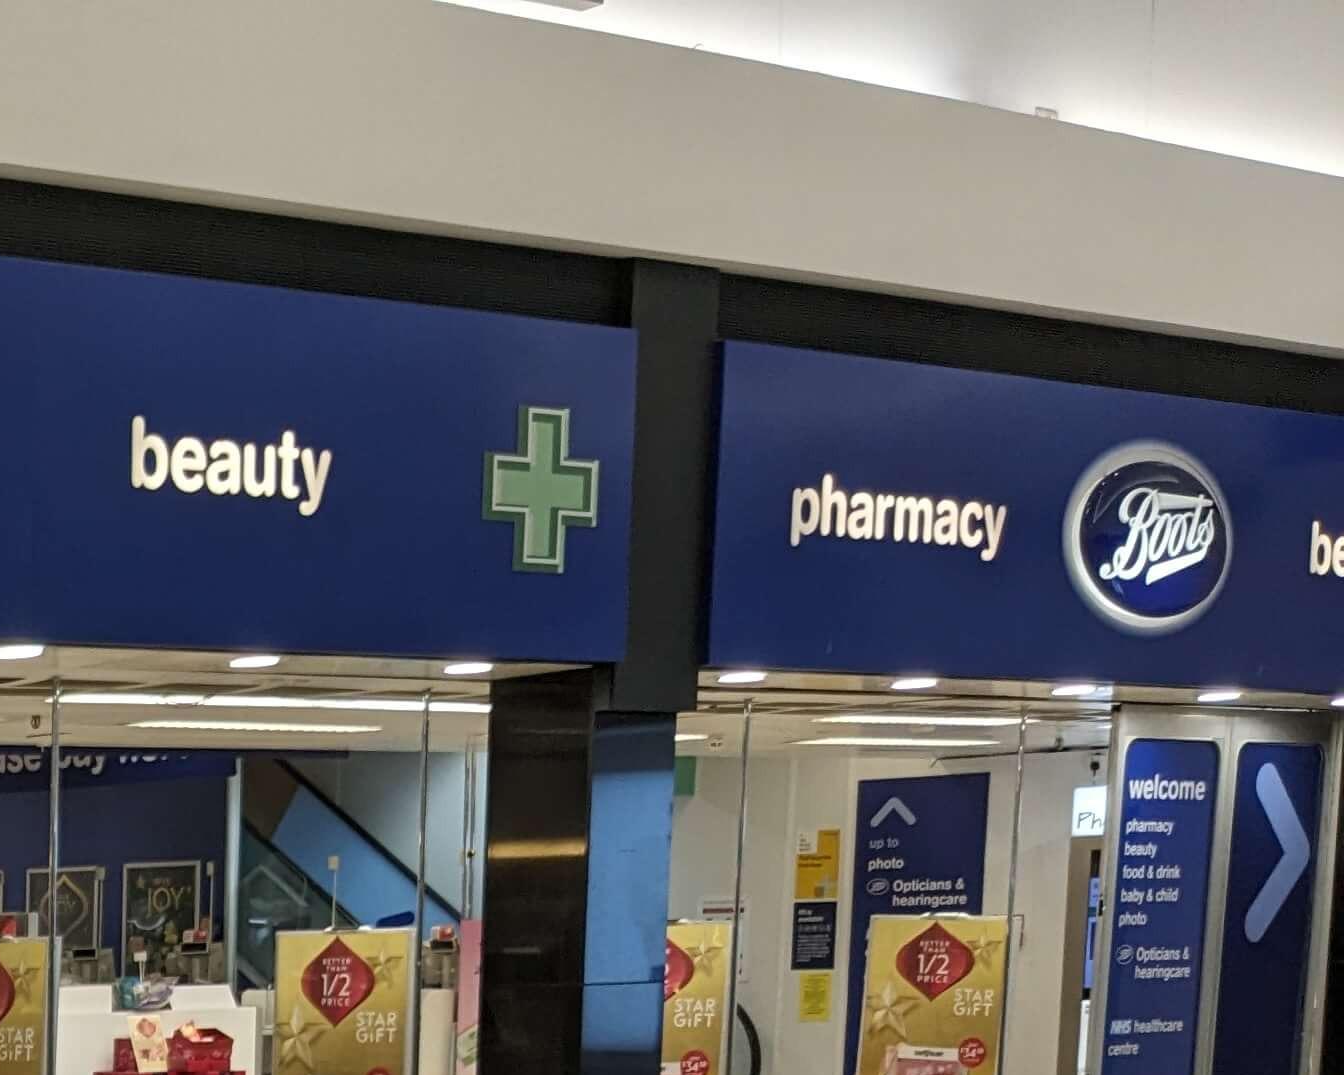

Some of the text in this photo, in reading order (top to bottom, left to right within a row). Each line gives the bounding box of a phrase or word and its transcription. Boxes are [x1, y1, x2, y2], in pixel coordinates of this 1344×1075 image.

[131, 415, 332, 518] beauty
[790, 473, 1008, 562] pharmacy
[1099, 487, 1215, 586] Boots
[1128, 773, 1206, 801] welcome
[1125, 818, 1175, 836] pharmacy
[869, 837, 899, 850] up to
[1123, 841, 1157, 858] beauty
[868, 857, 904, 873] photo
[1122, 864, 1181, 880] food & drink
[892, 878, 952, 894] Opticians
[955, 877, 965, 891] &
[892, 893, 968, 908] hearingcare
[1120, 887, 1180, 905] baby & child
[1118, 911, 1148, 928] photo
[1136, 947, 1180, 963] Opticians
[1182, 946, 1190, 960] &
[917, 953, 950, 975] 1/2
[1134, 964, 1191, 981] hearingcare
[321, 973, 352, 997] 1/2
[916, 975, 949, 984] PRICE
[320, 997, 351, 1007] PRICE
[953, 987, 994, 1002] STAR
[674, 997, 716, 1013] STAR
[356, 1011, 397, 1027] STAR
[1110, 1018, 1183, 1034] NHS healthcare
[1107, 1042, 1139, 1056] centre
